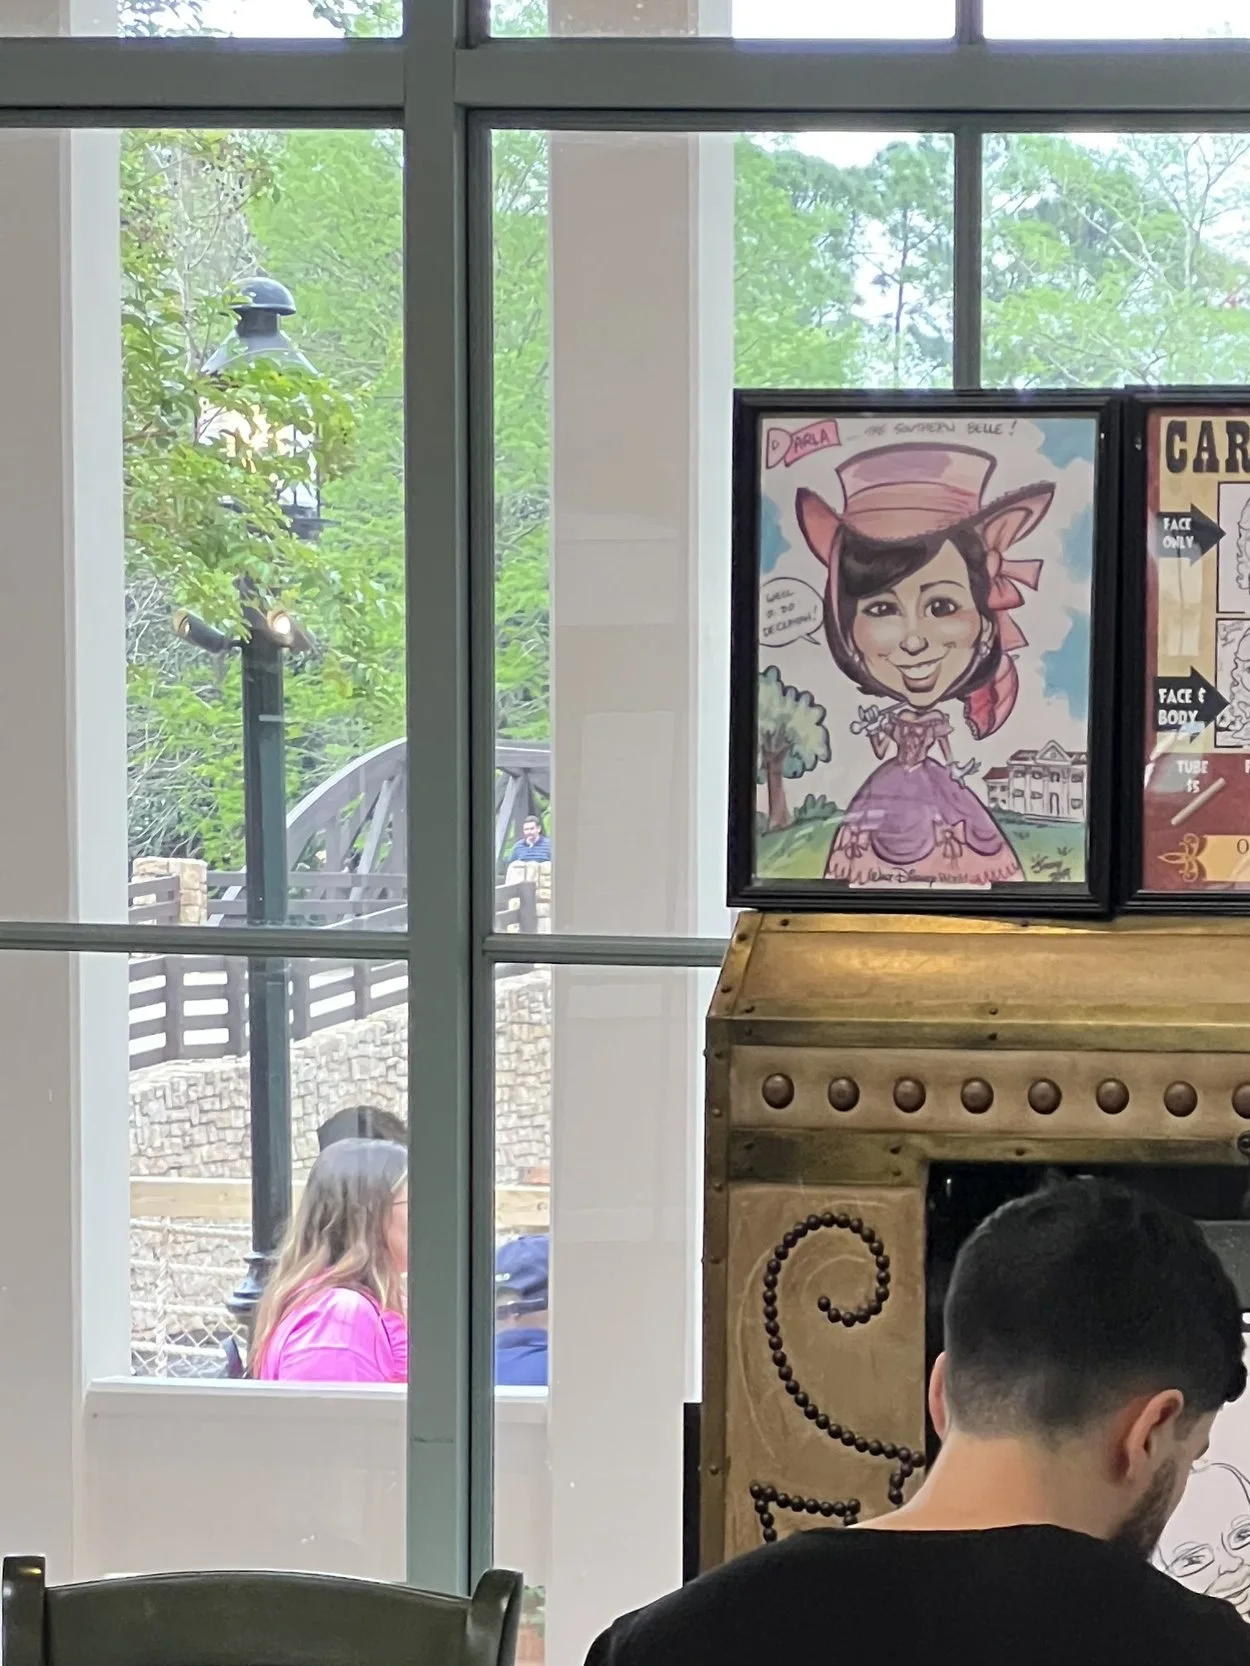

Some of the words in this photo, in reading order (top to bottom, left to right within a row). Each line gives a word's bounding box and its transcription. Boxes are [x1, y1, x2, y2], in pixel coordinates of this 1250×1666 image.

[766, 427, 833, 470] DARLA
[1163, 517, 1193, 532] FACE
[1162, 535, 1195, 550] ONLY
[1158, 687, 1193, 705] FACE
[1157, 708, 1199, 726] BODY
[1177, 759, 1208, 775] TUBE
[1186, 778, 1201, 794] $5
